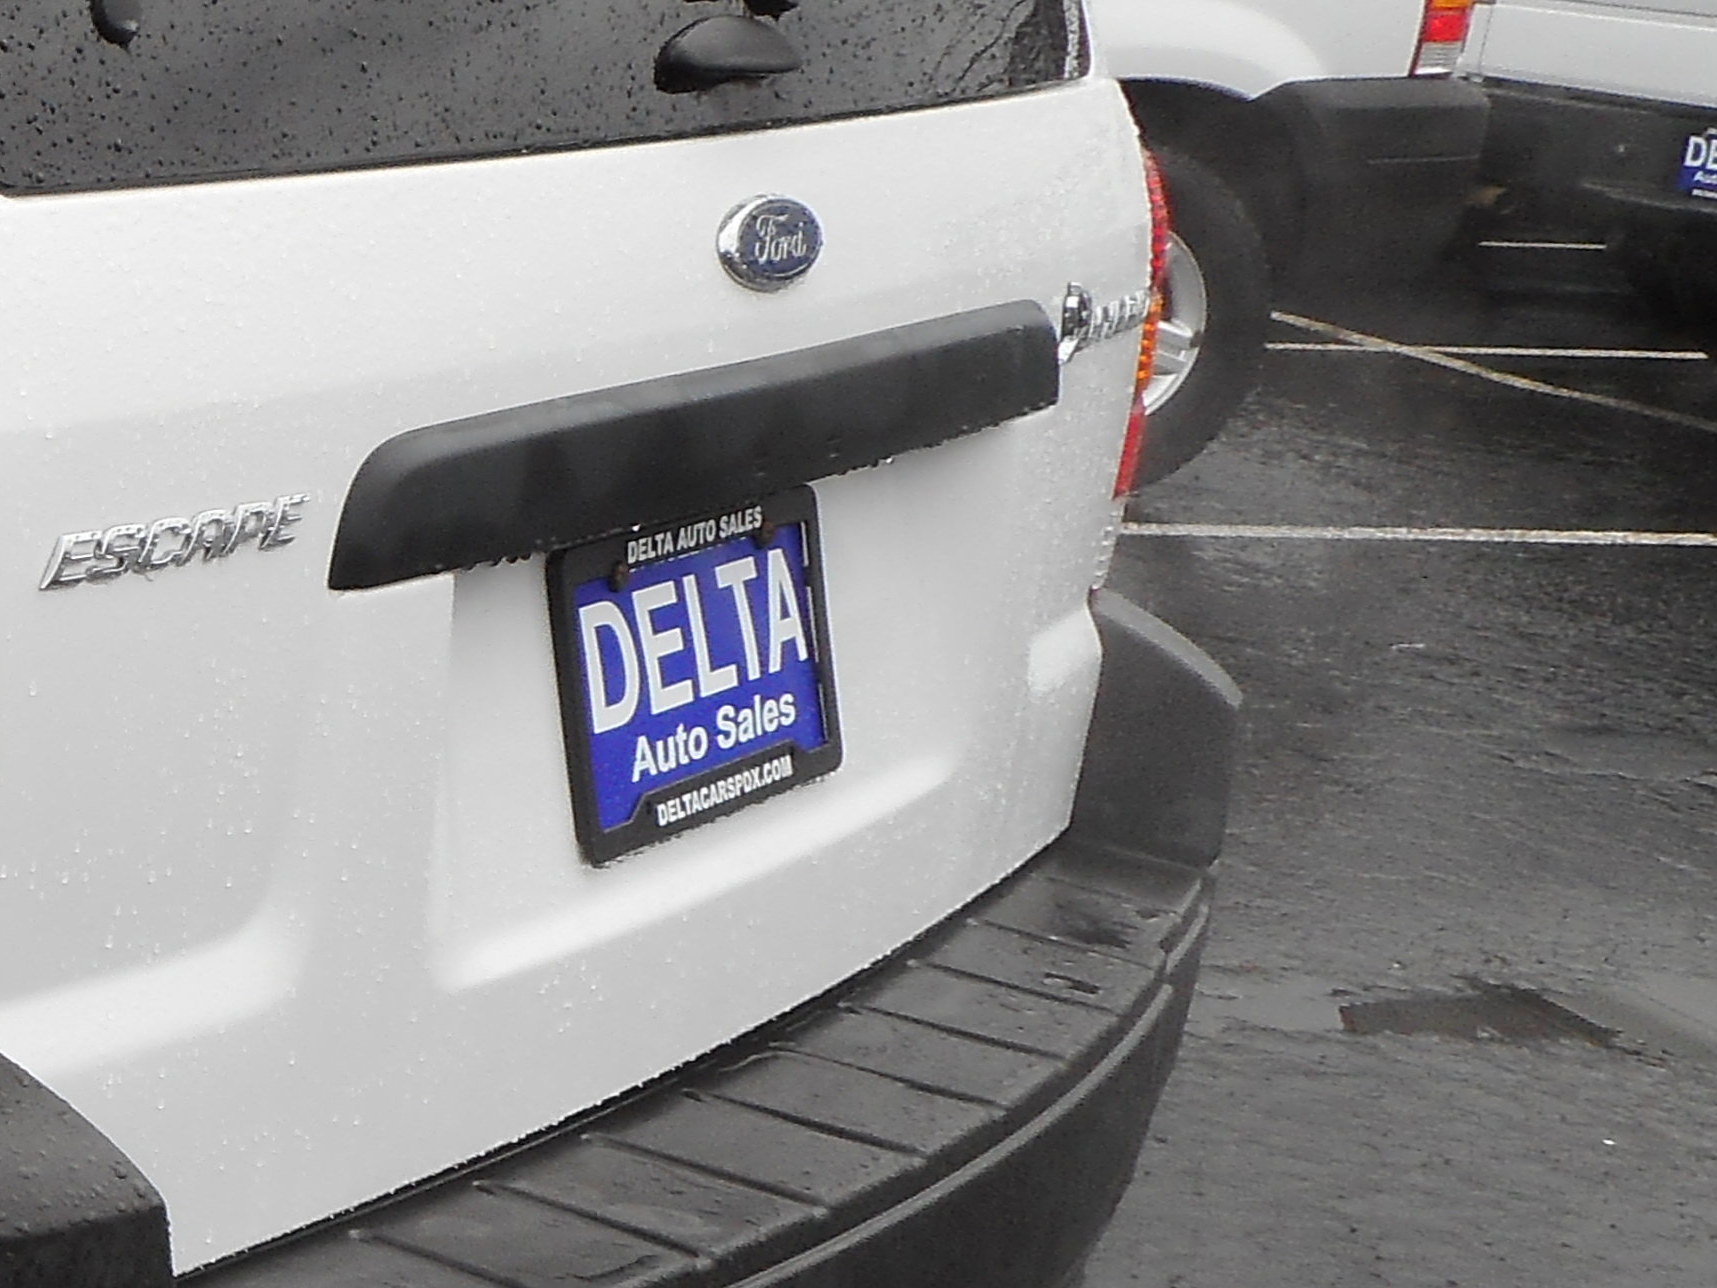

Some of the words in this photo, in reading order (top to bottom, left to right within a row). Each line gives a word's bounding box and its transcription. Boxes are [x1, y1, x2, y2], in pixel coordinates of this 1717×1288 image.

[754, 213, 807, 265] Ford
[38, 492, 312, 591] ESCAPE
[627, 532, 675, 564] DELTA
[677, 519, 716, 550] AUTO
[719, 505, 763, 537] SALES
[578, 548, 808, 734] DELTA
[631, 723, 708, 783] Auto
[716, 693, 797, 749] Sales
[656, 754, 794, 827] DELTACARSPDX.COM
